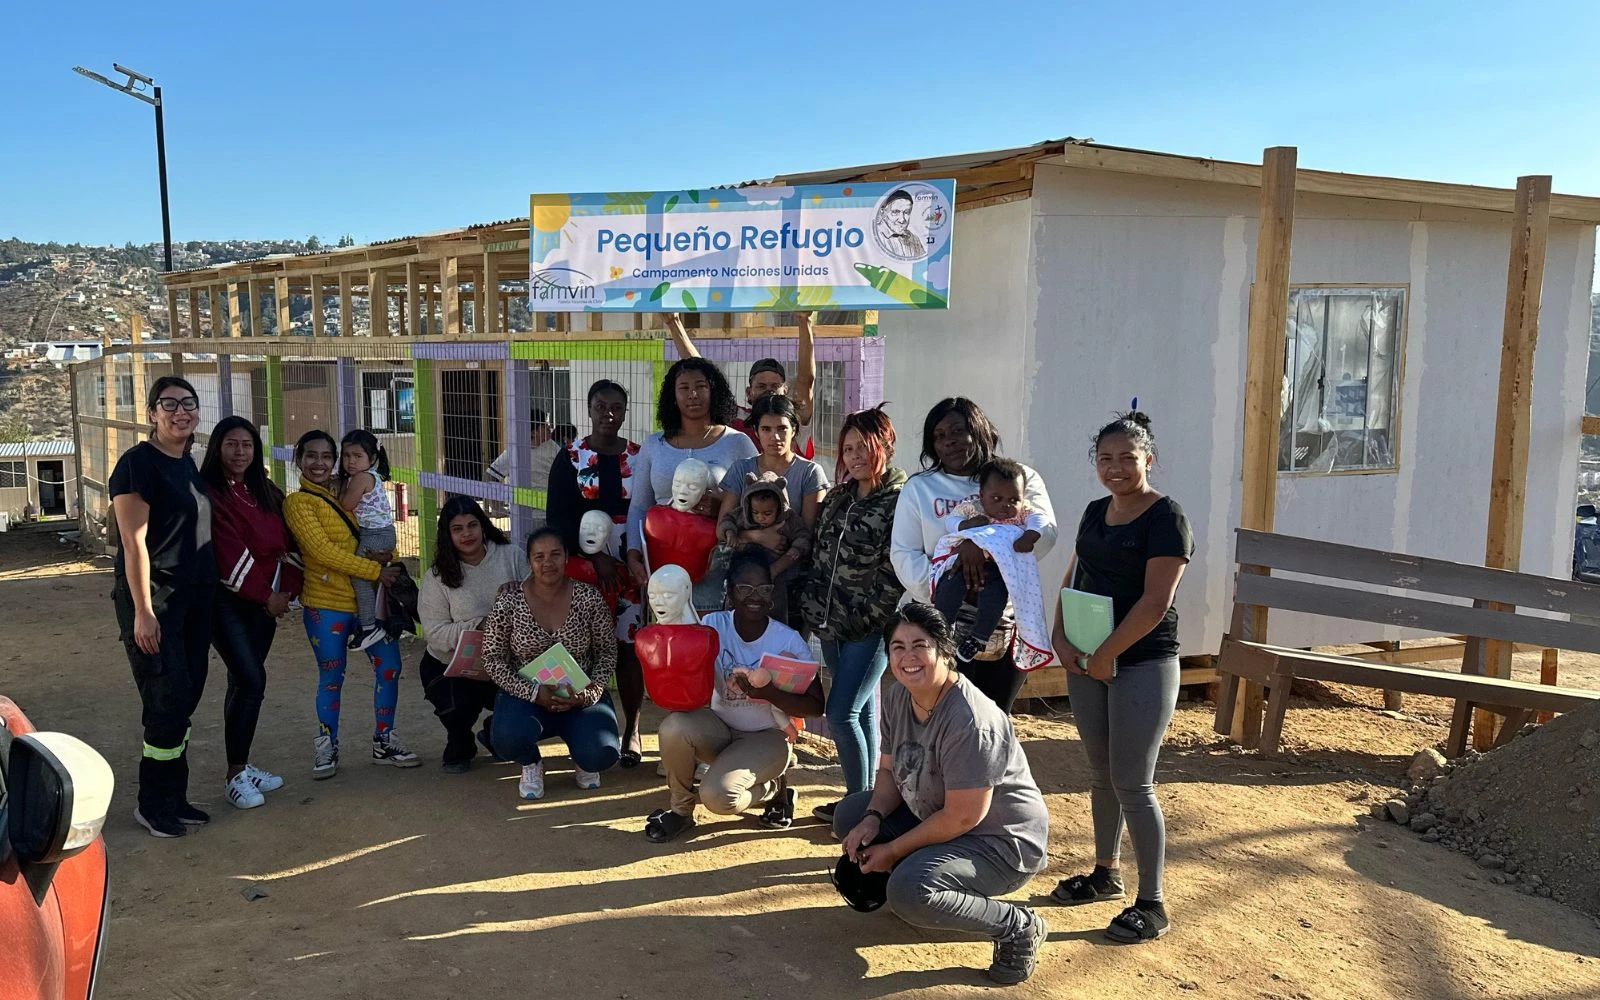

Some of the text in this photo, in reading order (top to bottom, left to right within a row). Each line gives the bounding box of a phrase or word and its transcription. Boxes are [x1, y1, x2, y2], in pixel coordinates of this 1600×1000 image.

[597, 225, 731, 260] Pequeño
[740, 220, 865, 257] Refugio
[632, 264, 829, 281] Campamento Naciones Unidas
[532, 280, 595, 302] famvin
